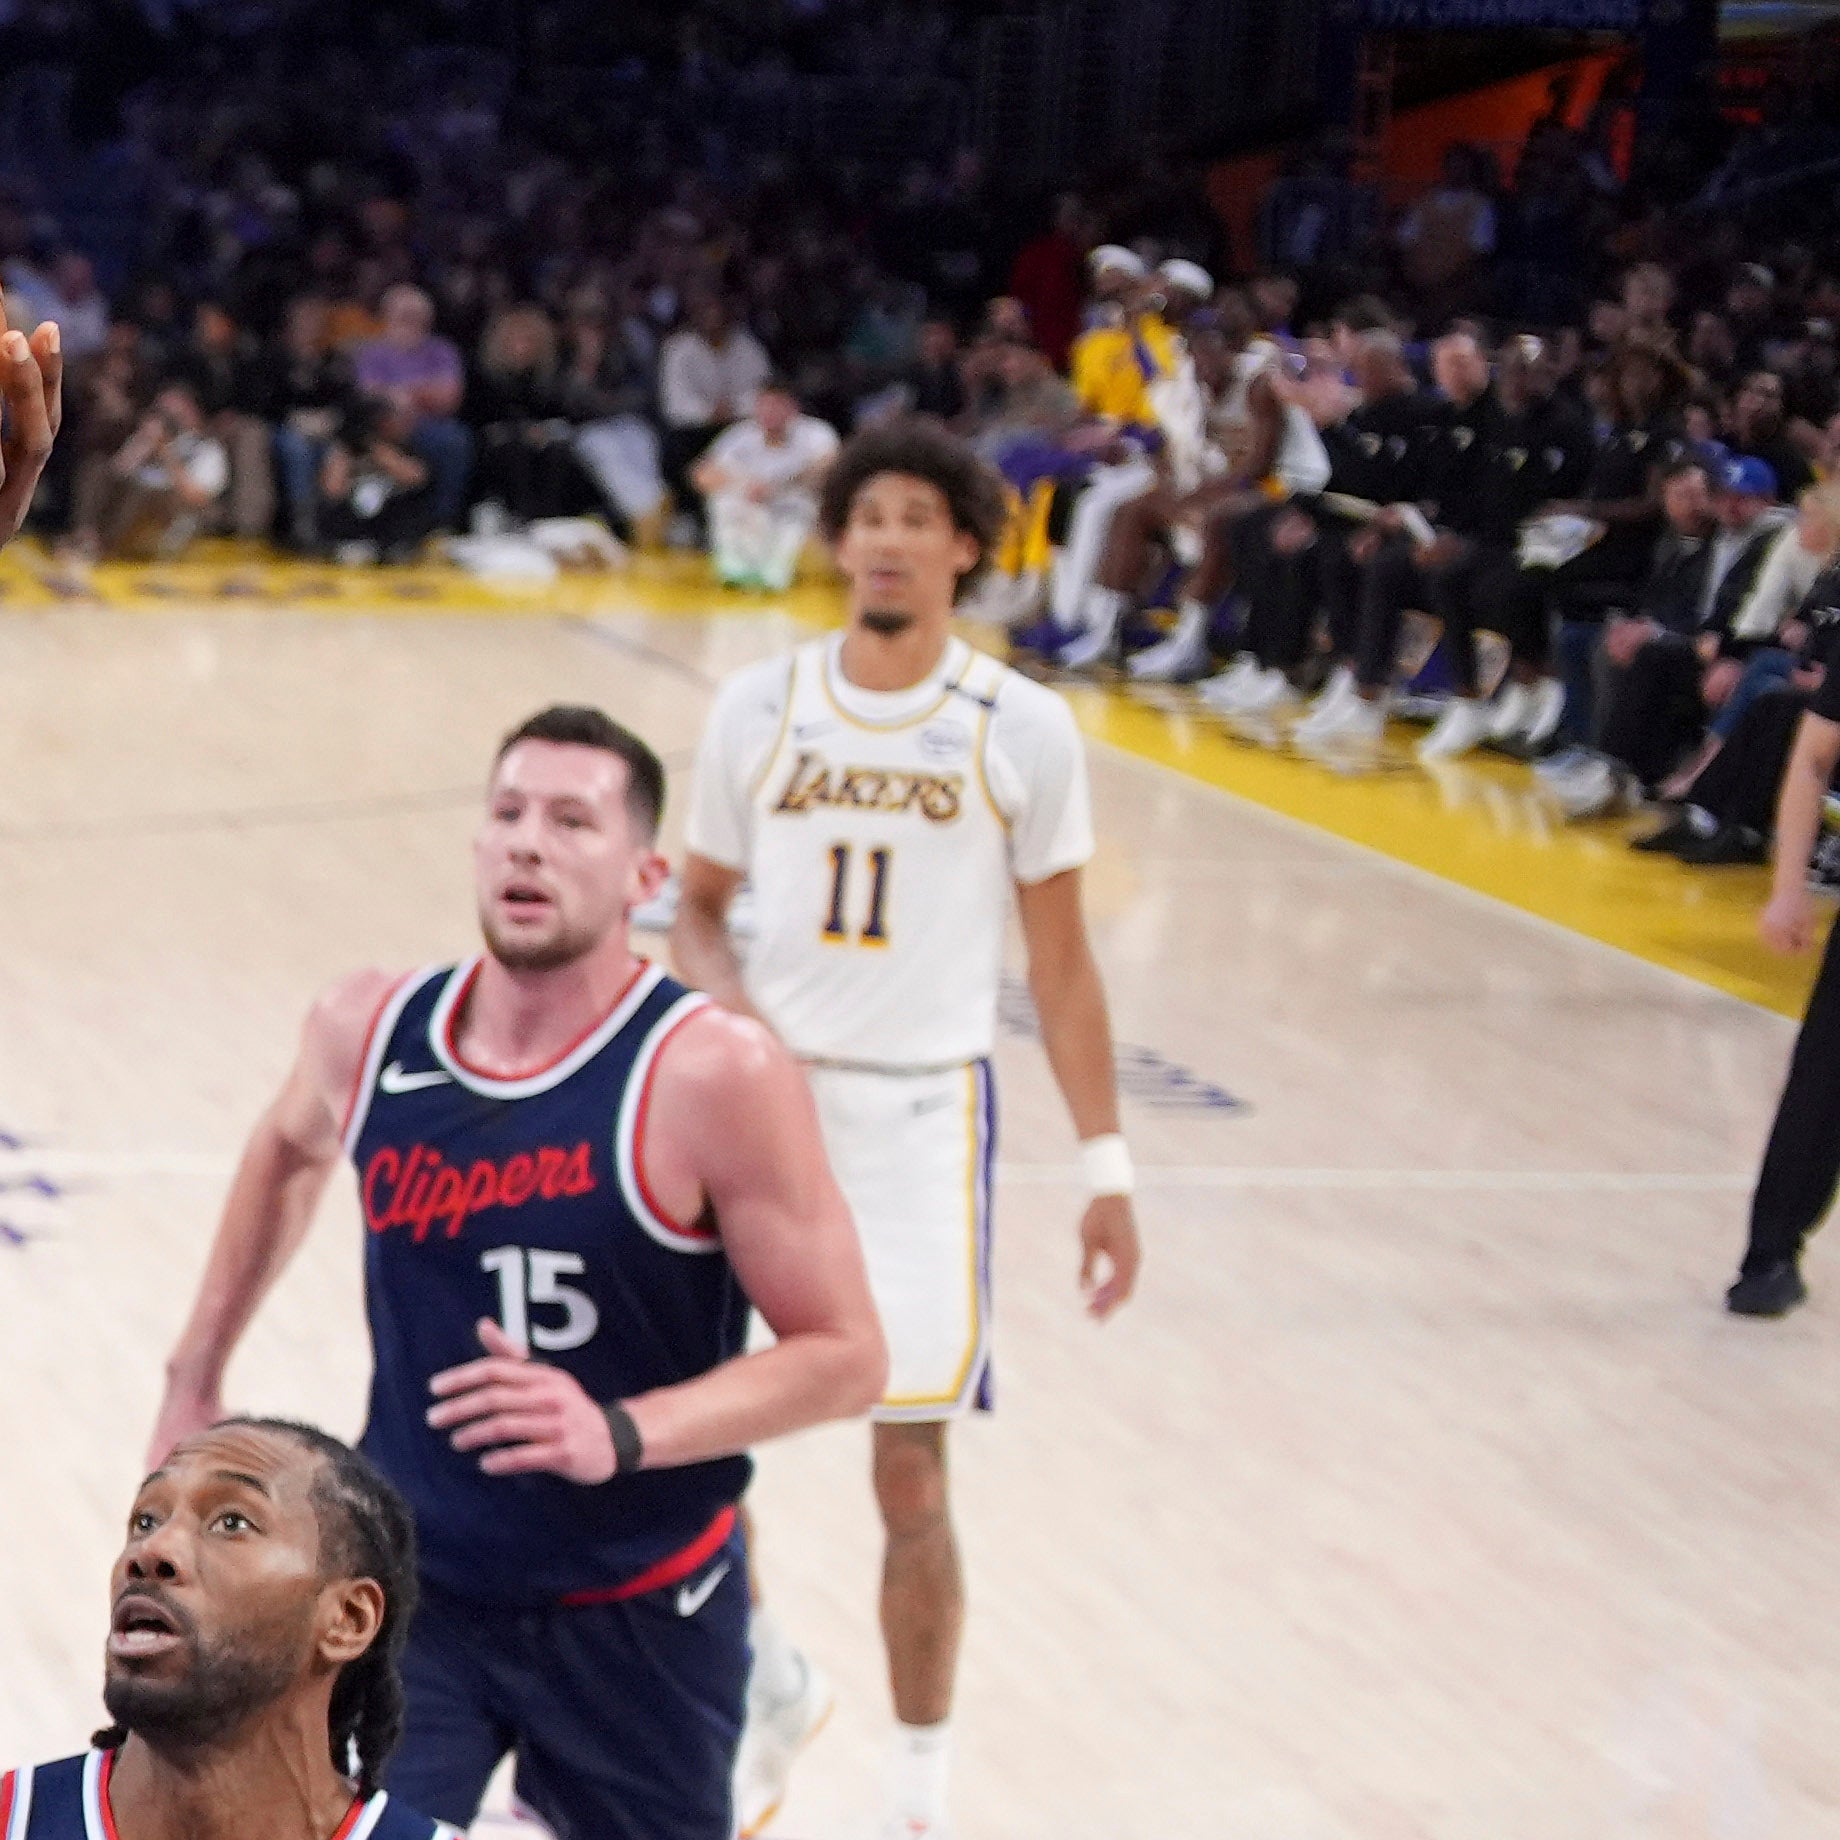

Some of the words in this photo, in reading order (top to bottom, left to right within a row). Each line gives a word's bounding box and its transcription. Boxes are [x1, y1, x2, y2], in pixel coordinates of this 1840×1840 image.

[773, 751, 963, 823] LAKERS
[821, 842, 893, 945] 11
[363, 1142, 597, 1241] Clippers
[480, 1244, 598, 1351] 15
